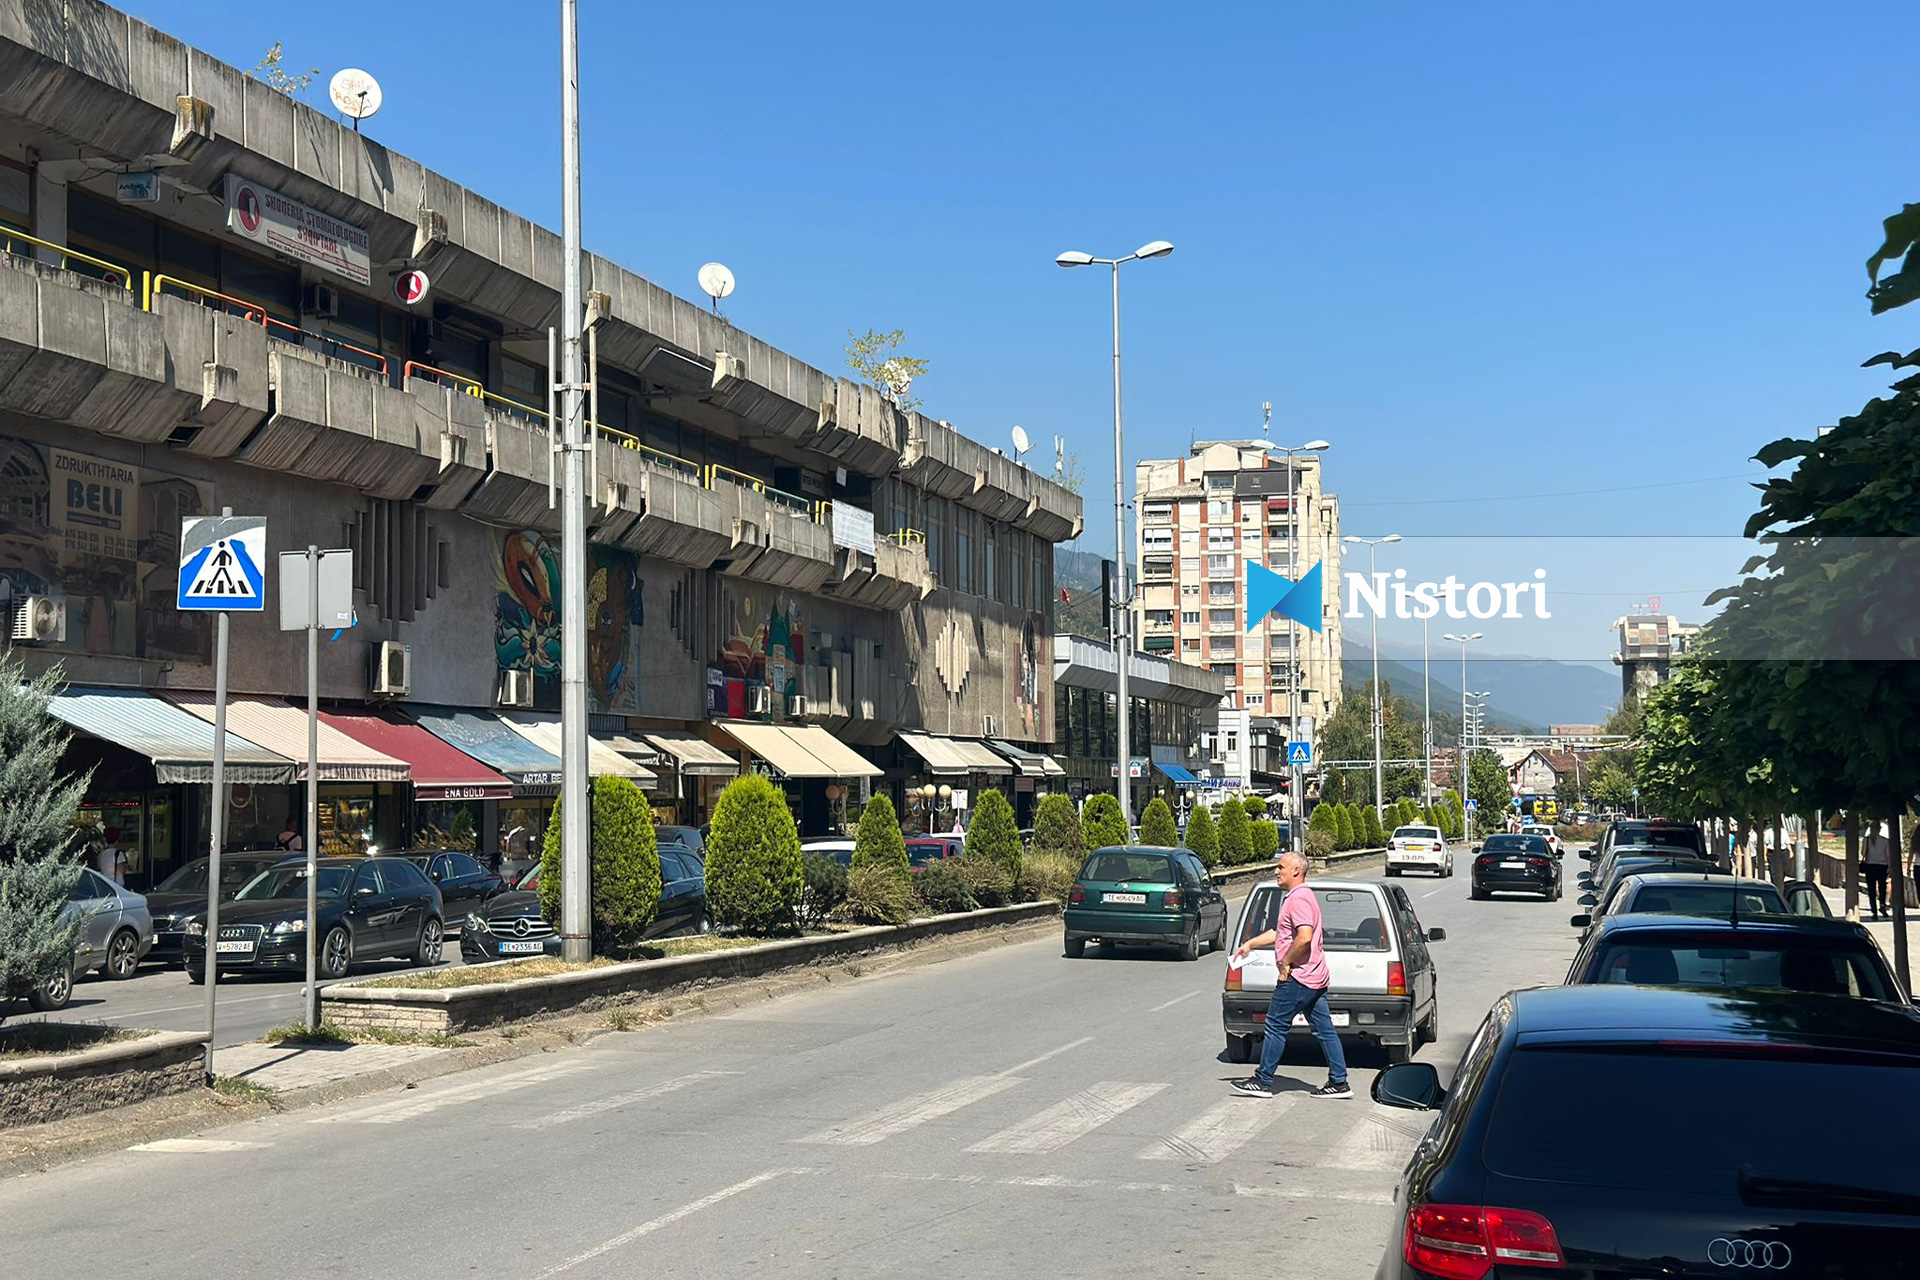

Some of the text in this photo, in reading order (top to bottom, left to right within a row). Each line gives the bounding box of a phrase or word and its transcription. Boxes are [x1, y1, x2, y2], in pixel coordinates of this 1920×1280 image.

[55, 455, 134, 484] ZDRUKTHTARIA
[67, 478, 122, 516] BELI
[522, 773, 548, 783] ARTAR
[444, 787, 485, 798] ENA GOLD
